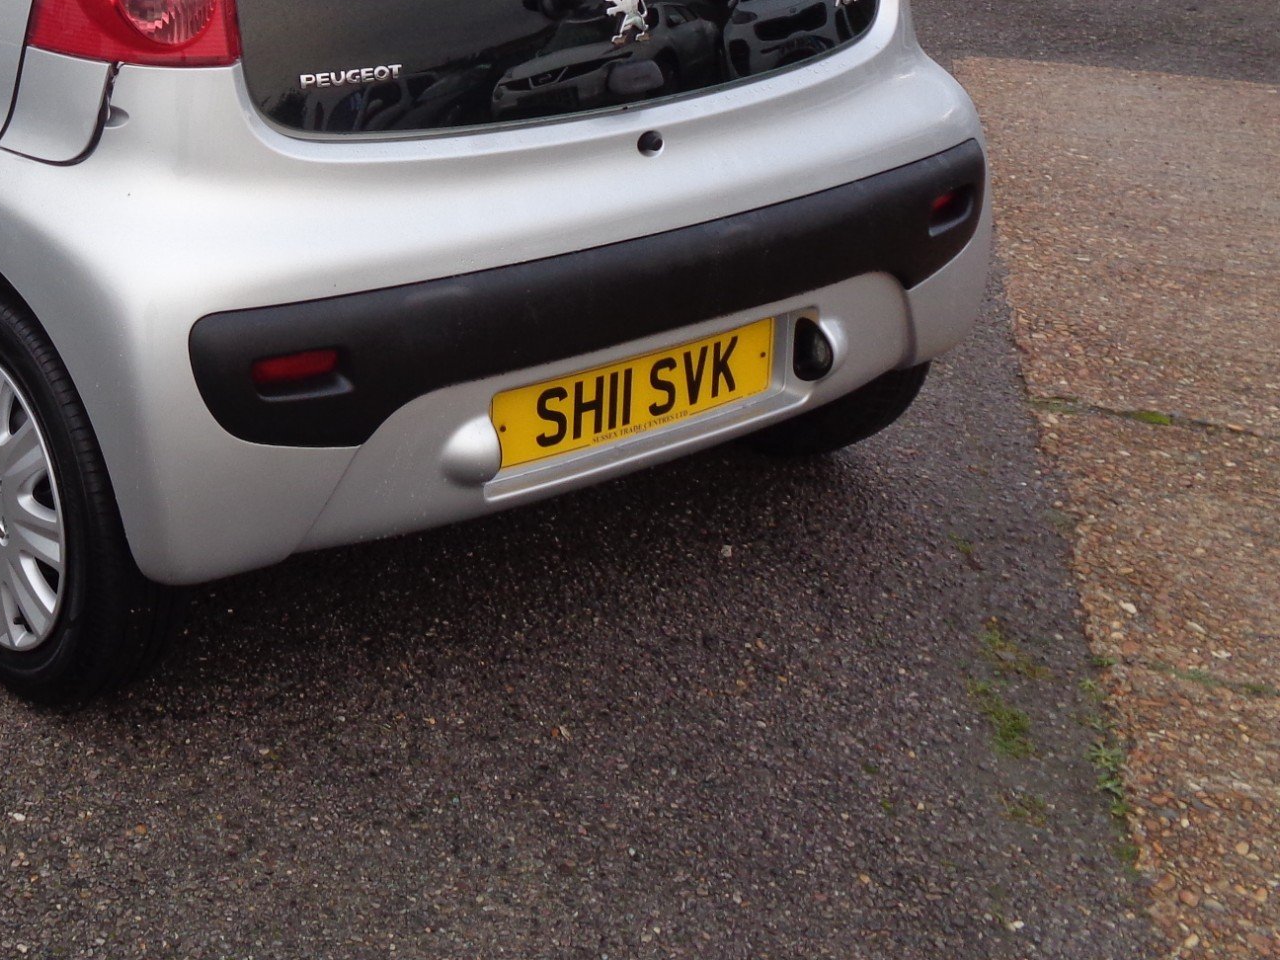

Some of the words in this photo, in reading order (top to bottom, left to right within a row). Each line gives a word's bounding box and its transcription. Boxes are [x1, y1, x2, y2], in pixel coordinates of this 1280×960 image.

[299, 64, 403, 89] PEUGEOT
[535, 367, 633, 448] SH11
[648, 335, 739, 417] SVK
[619, 424, 642, 436] TRADE
